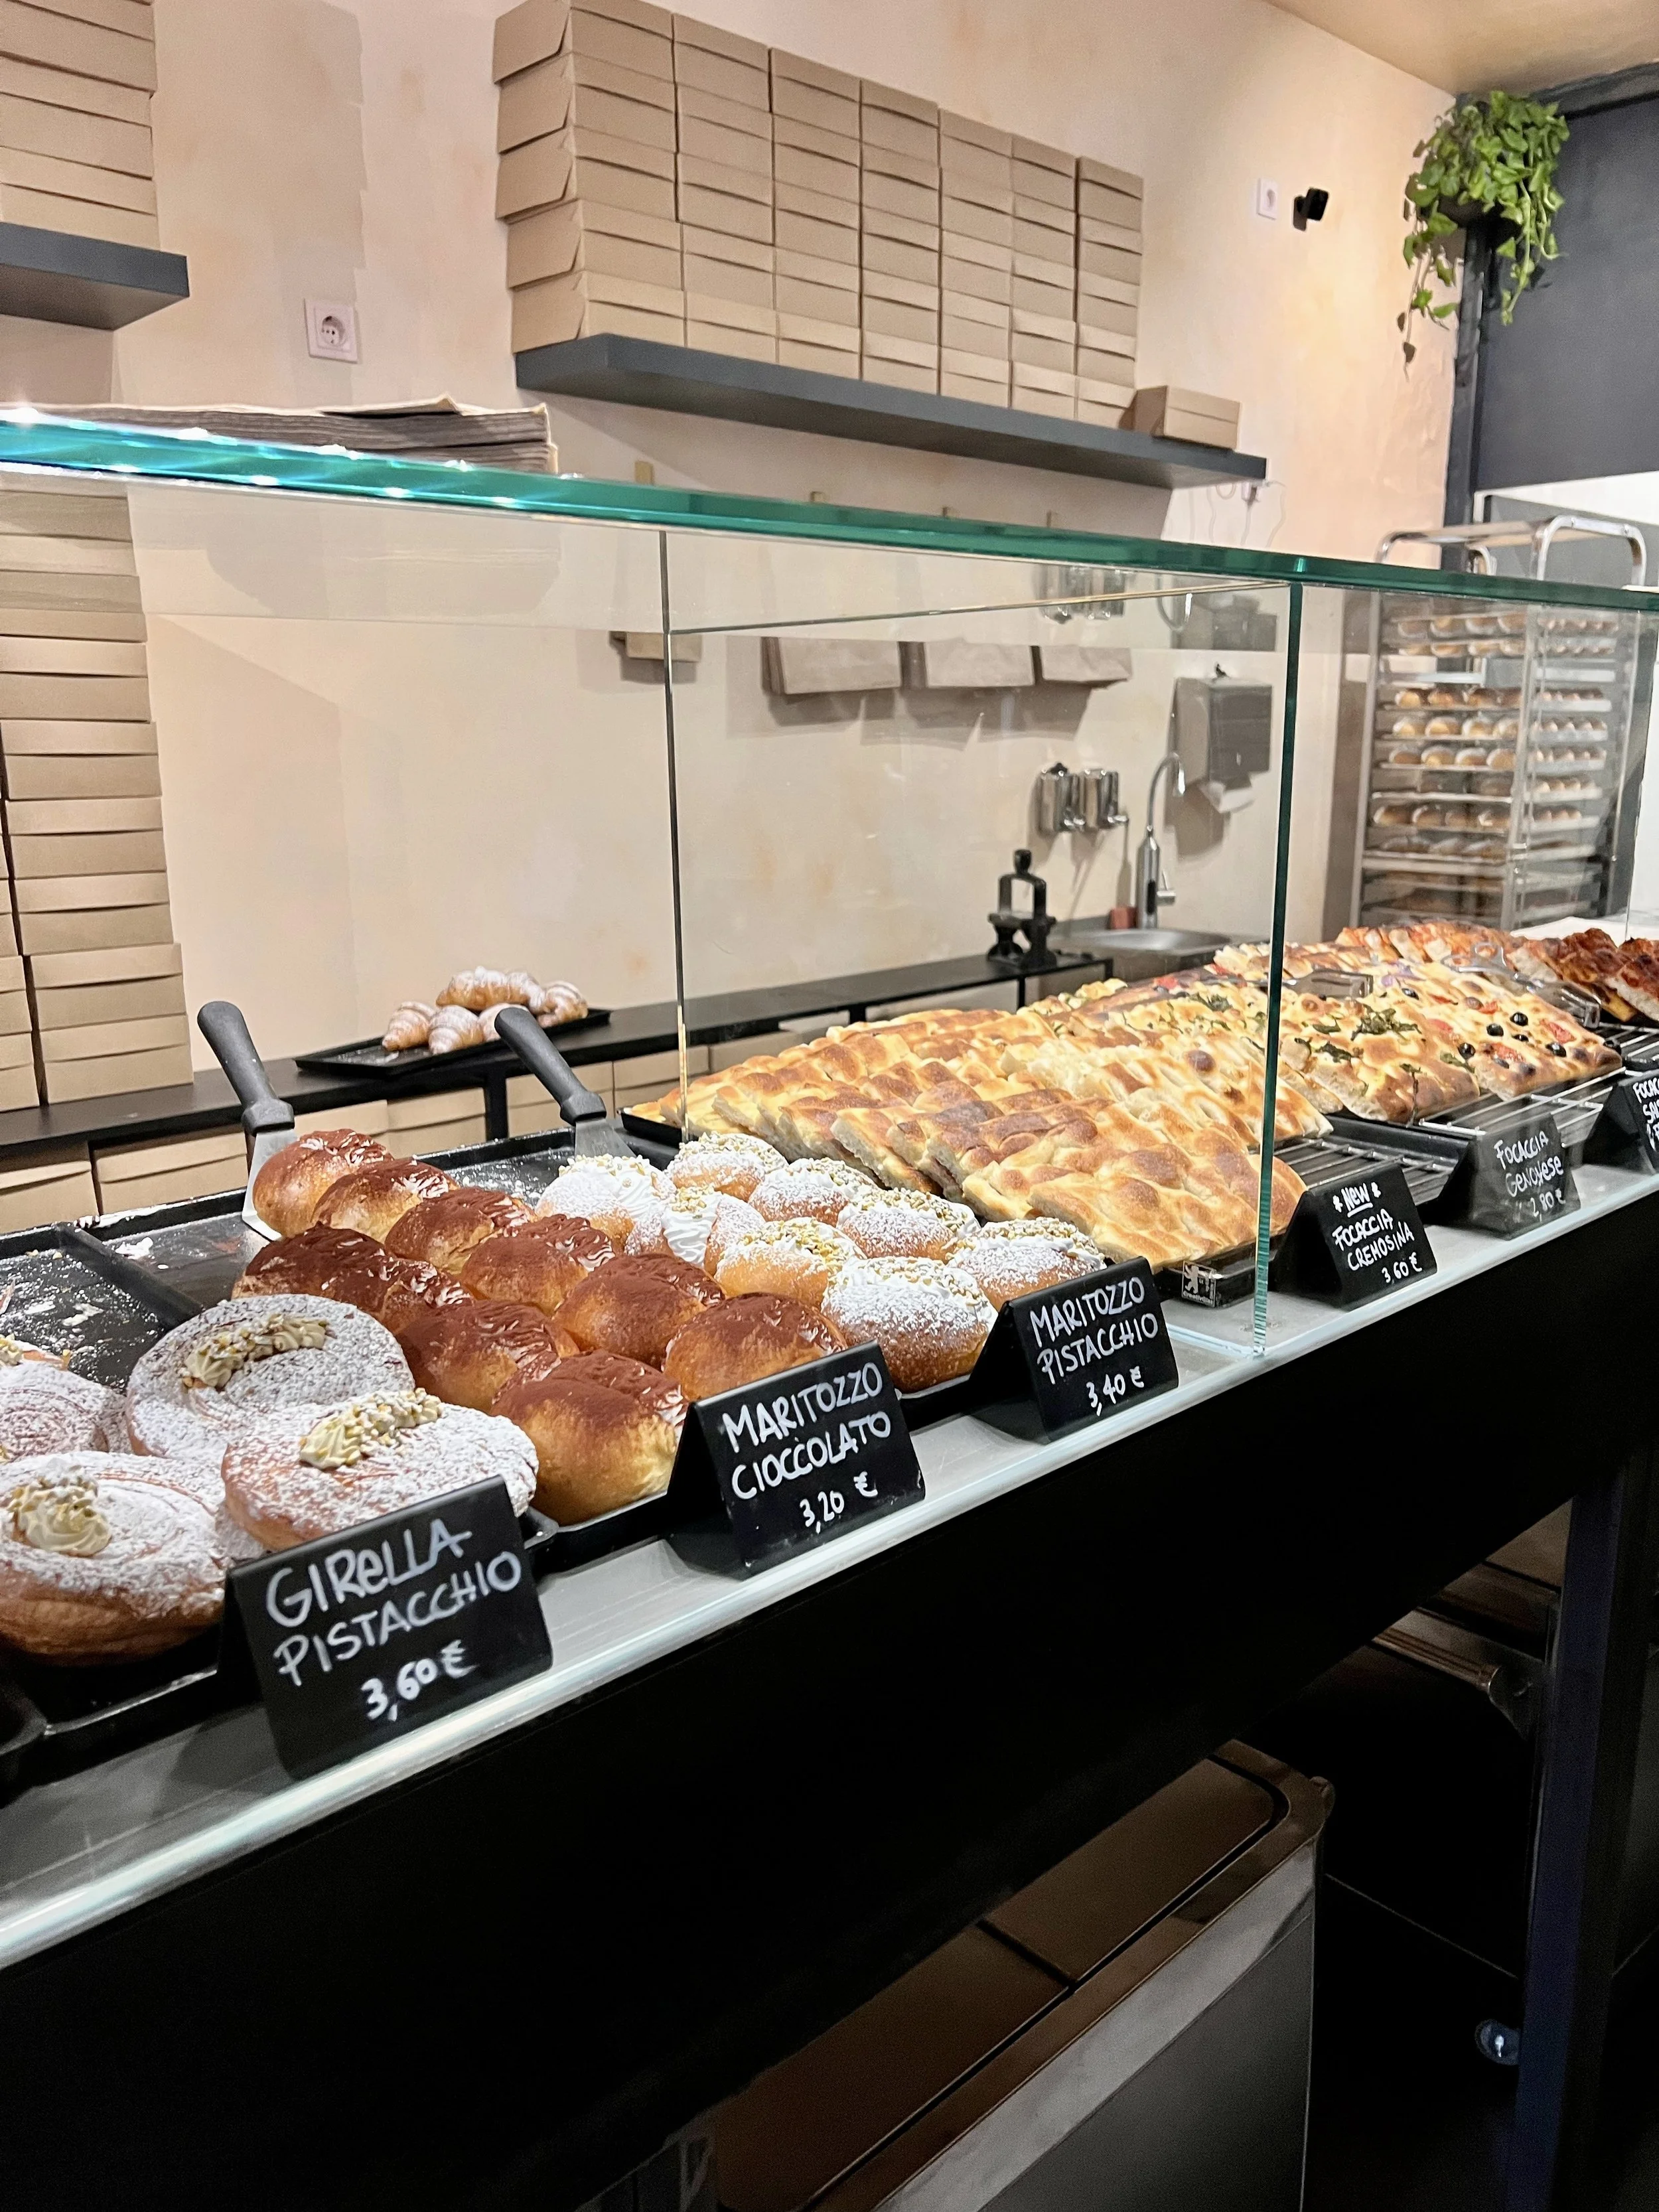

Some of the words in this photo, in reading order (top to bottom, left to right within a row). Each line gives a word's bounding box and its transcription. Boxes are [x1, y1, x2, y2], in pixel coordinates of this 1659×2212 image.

[1494, 1131, 1549, 1170] FOCACCIA
[1332, 1209, 1393, 1251] FOCACCIA
[1347, 1221, 1415, 1271] CREMOSINA
[1409, 1252, 1422, 1272] €
[1030, 1277, 1145, 1348] MARITOZZO
[1037, 1313, 1158, 1385] PISTACCHIO
[722, 1362, 883, 1453] MARITOZZO
[1086, 1374, 1125, 1416] 3,40
[1129, 1366, 1145, 1388] €
[732, 1411, 891, 1500] CIOCCOLATO
[800, 1491, 844, 1534] 3,20
[853, 1471, 878, 1497] €
[273, 1551, 522, 1686] PISTACCHIO
